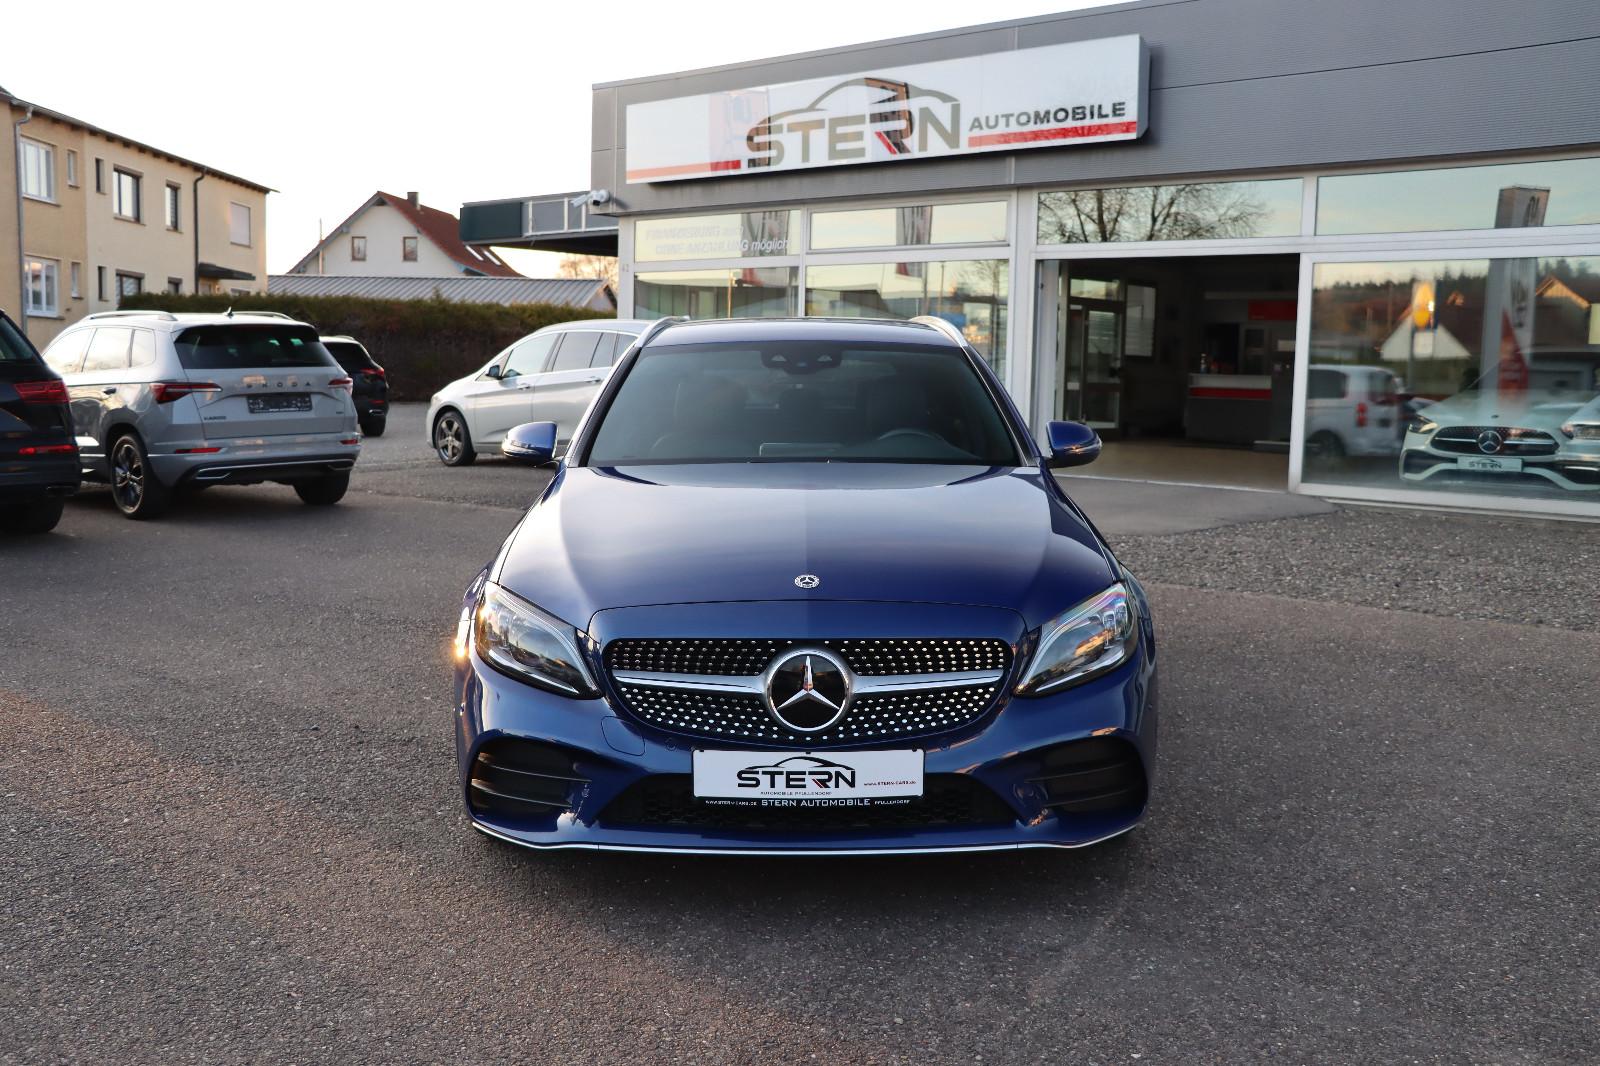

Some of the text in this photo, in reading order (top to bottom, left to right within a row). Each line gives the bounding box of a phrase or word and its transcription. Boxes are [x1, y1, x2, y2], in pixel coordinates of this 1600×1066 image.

[747, 100, 1126, 168] STERN AUTOMOBILE
[752, 238, 789, 252] möglich
[737, 770, 856, 788] STERN
[762, 799, 797, 807] STERN
[800, 798, 870, 807] AUTOMOBILE
